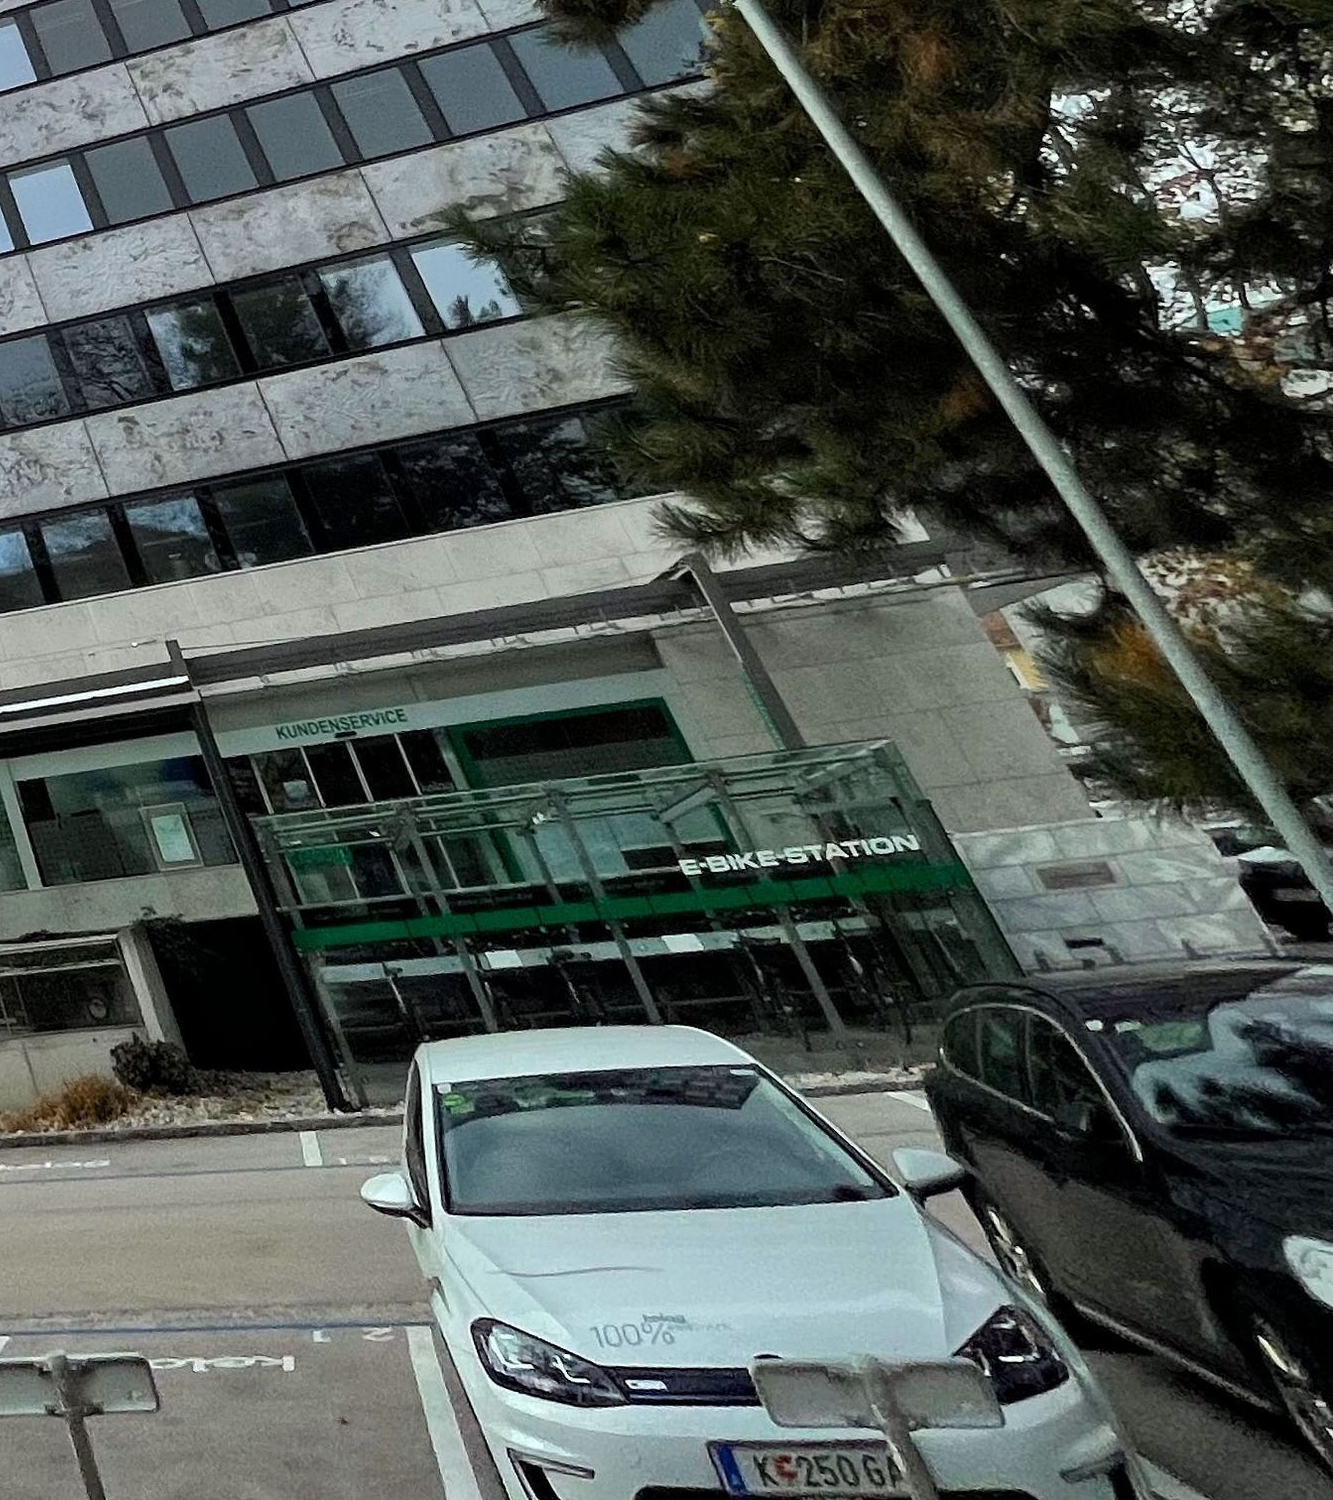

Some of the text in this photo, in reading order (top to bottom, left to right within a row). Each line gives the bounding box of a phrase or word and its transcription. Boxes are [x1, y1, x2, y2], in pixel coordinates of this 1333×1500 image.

[275, 709, 408, 740] KUNDENSERVICE
[677, 834, 921, 877] E-BIKE-STATION
[590, 1322, 675, 1348] 100%
[148, 1355, 295, 1373] kela
[753, 1453, 779, 1487] K
[796, 1454, 860, 1488] 250
